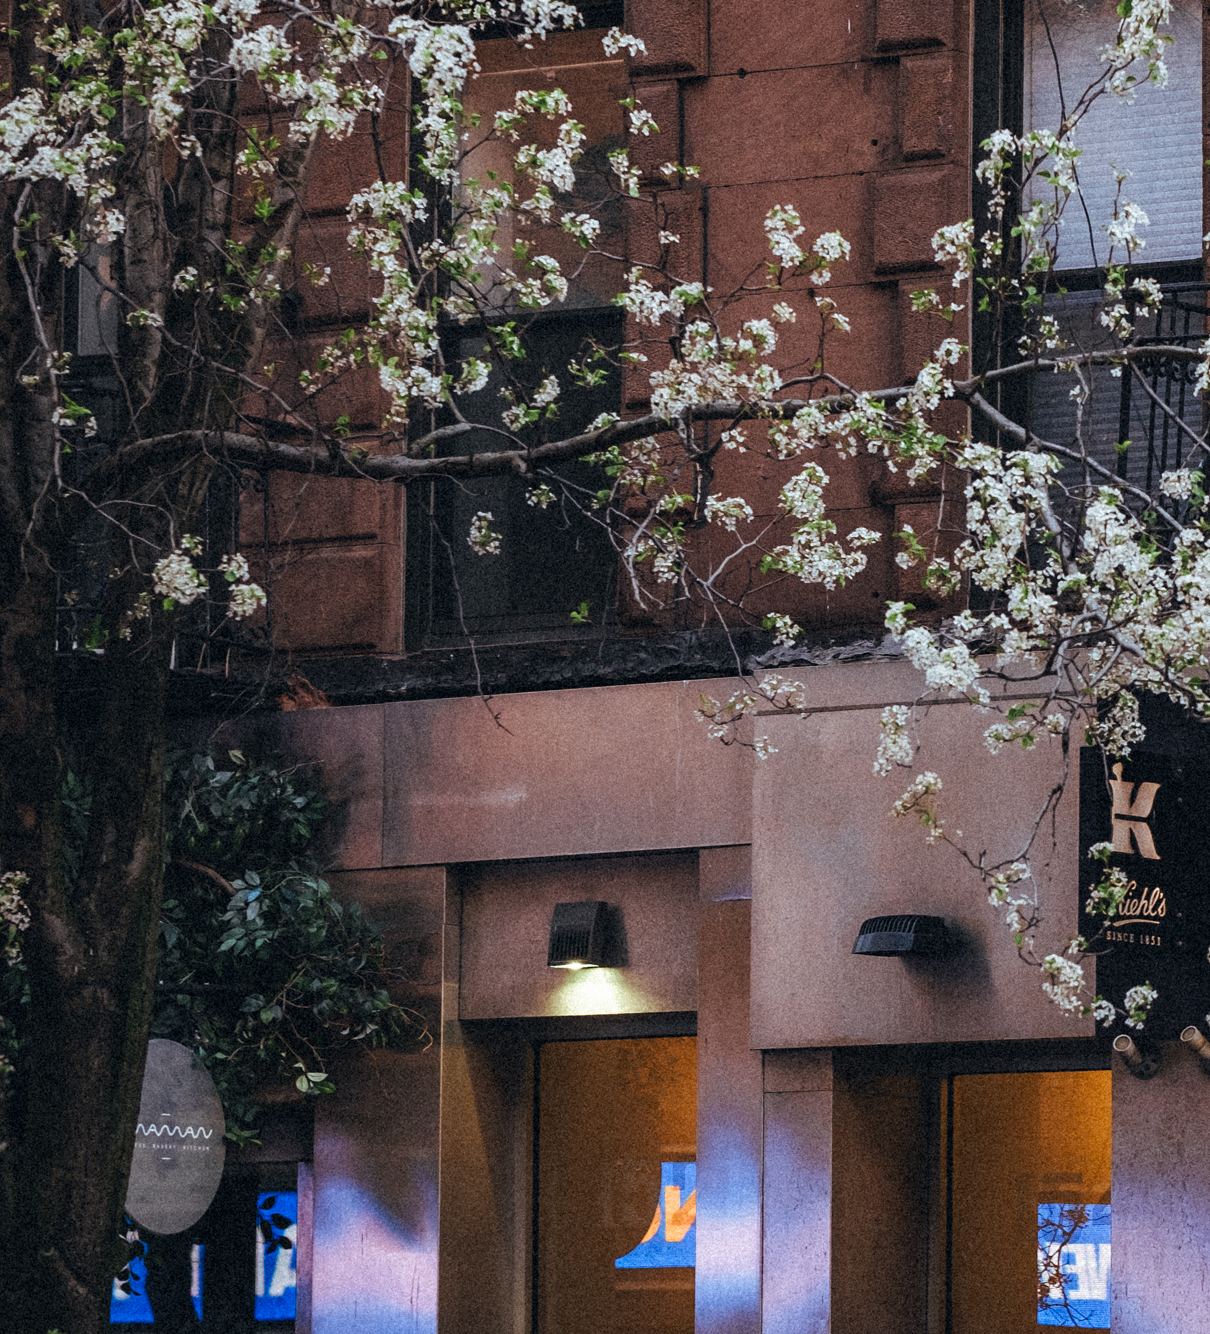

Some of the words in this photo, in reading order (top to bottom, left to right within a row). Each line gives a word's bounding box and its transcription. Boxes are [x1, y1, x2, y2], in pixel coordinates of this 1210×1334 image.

[1117, 880, 1167, 917] iehl's
[1106, 930, 1135, 943] SINCE
[1139, 934, 1161, 946] 1851
